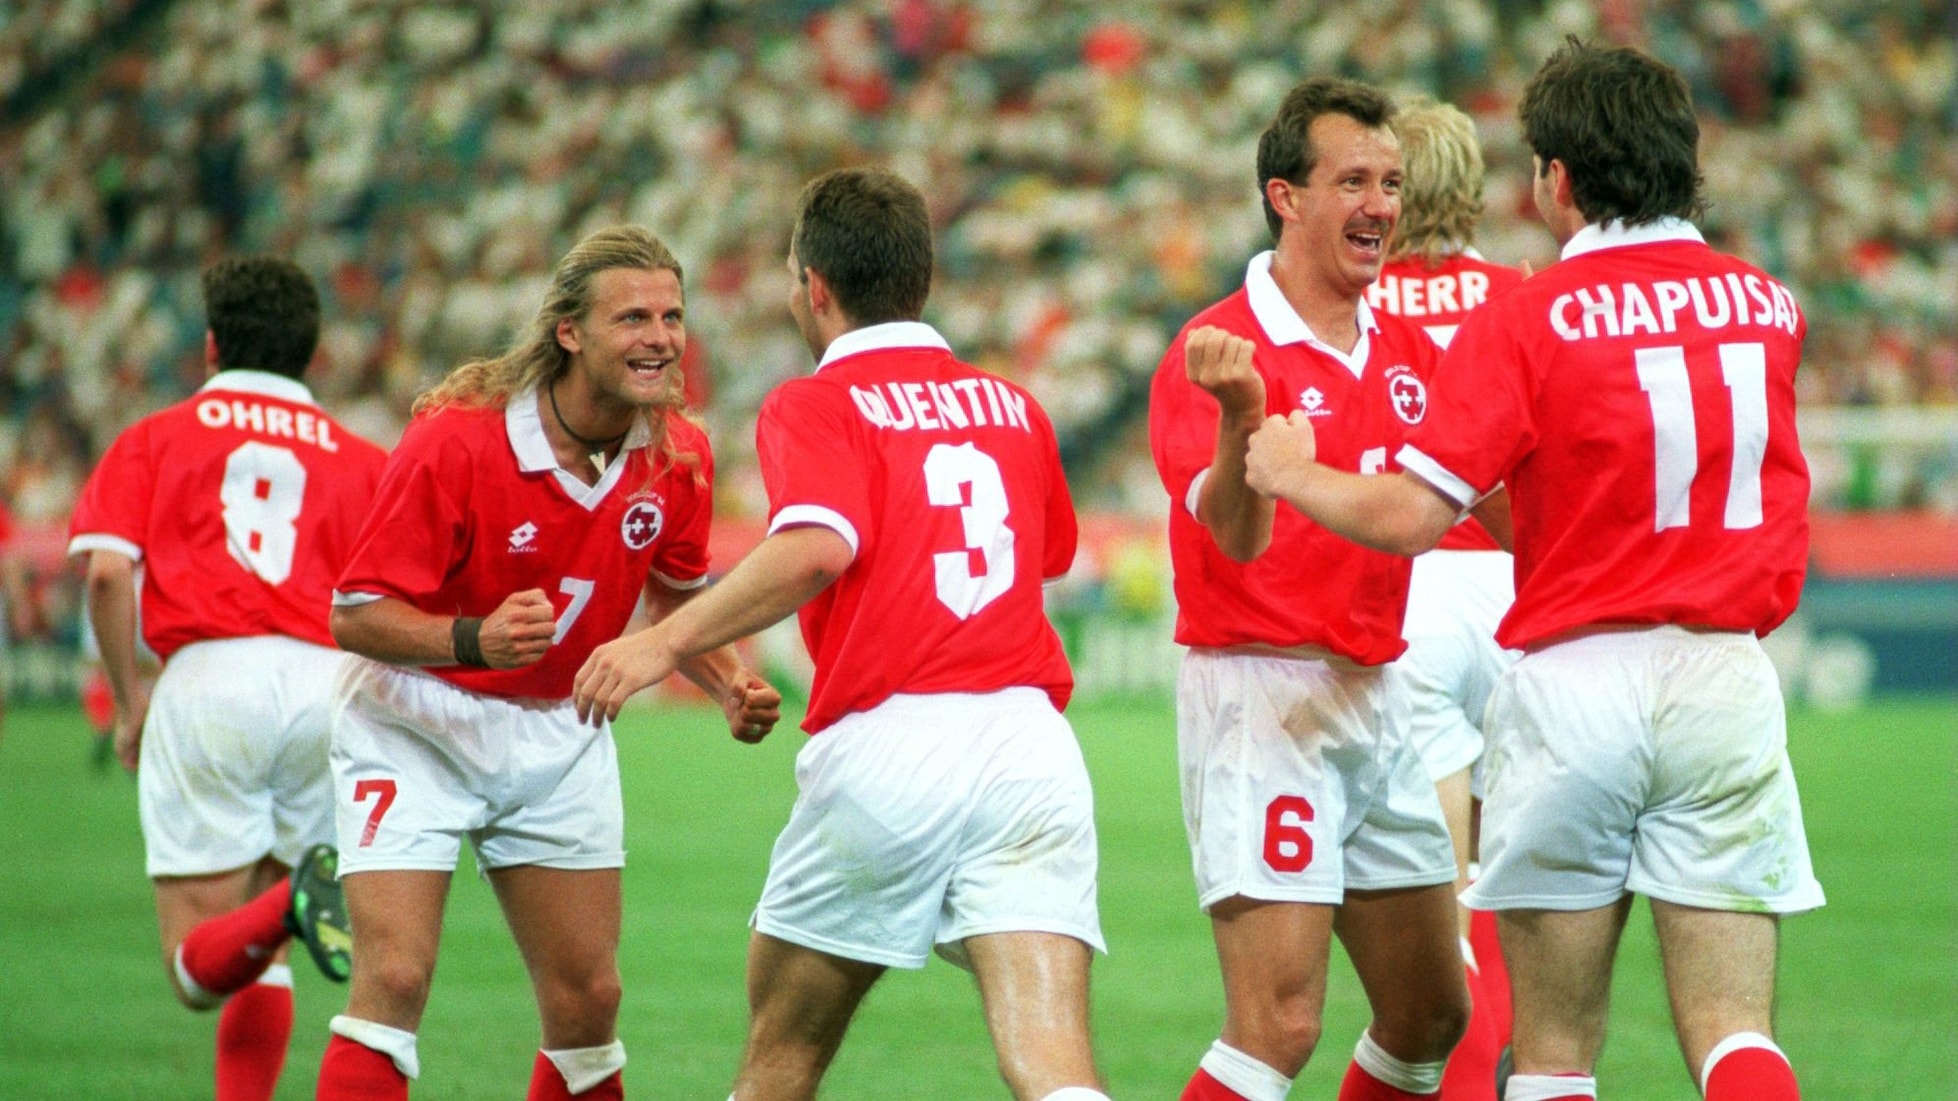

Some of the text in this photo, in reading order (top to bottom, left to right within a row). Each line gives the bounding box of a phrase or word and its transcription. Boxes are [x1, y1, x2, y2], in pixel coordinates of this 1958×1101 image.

[1367, 270, 1489, 316] HERR
[197, 400, 339, 453] OHREL
[849, 378, 1031, 434] QUENTIN
[1634, 342, 1769, 533] 11
[220, 440, 307, 586] 8
[922, 441, 1015, 620] 3
[552, 577, 595, 645] 7
[353, 780, 397, 848] 7
[1263, 795, 1314, 873] 6
